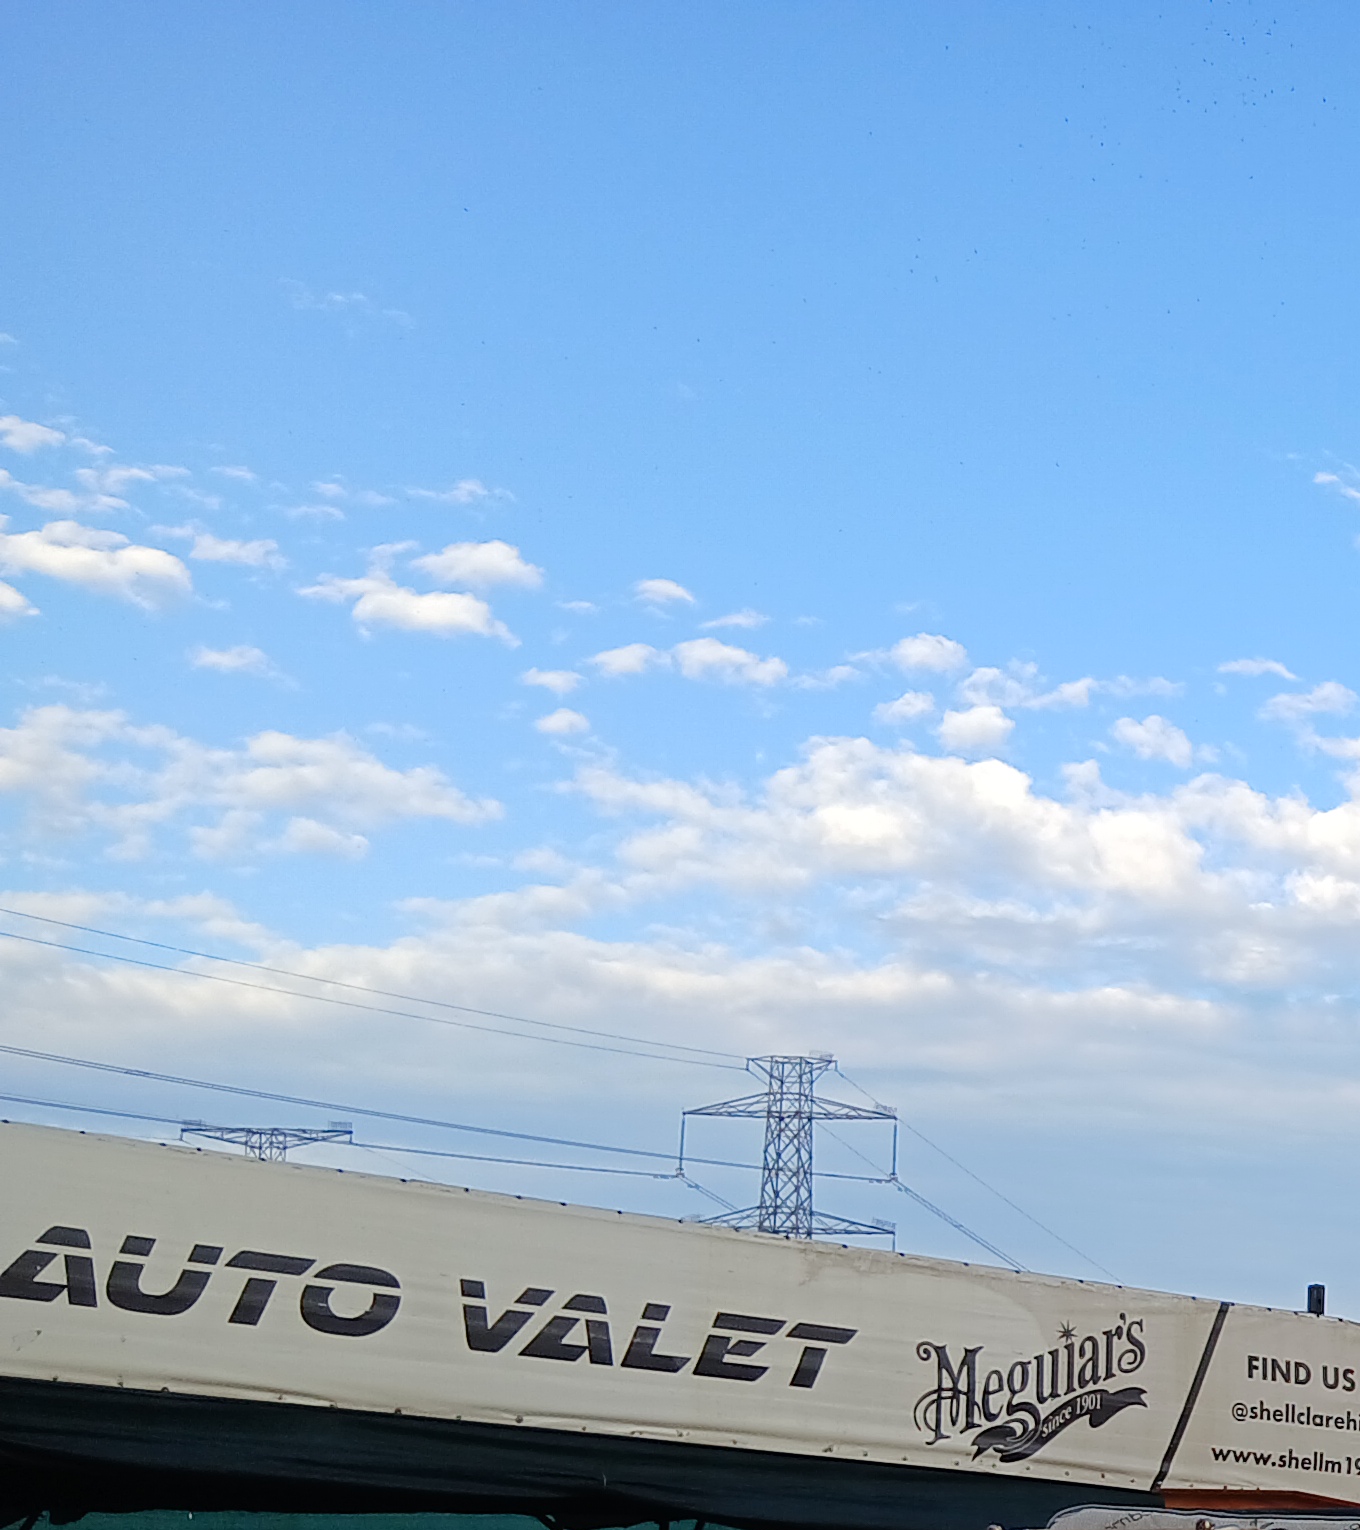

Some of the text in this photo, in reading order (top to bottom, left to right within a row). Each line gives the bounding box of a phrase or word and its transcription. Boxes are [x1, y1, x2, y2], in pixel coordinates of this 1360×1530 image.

[0, 1226, 858, 1388] AUTO VALET
[914, 1312, 1146, 1445] Meguiar's
[1042, 1394, 1101, 1438] since 1901
[1248, 1355, 1311, 1385] FIND
[1322, 1365, 1356, 1392] US
